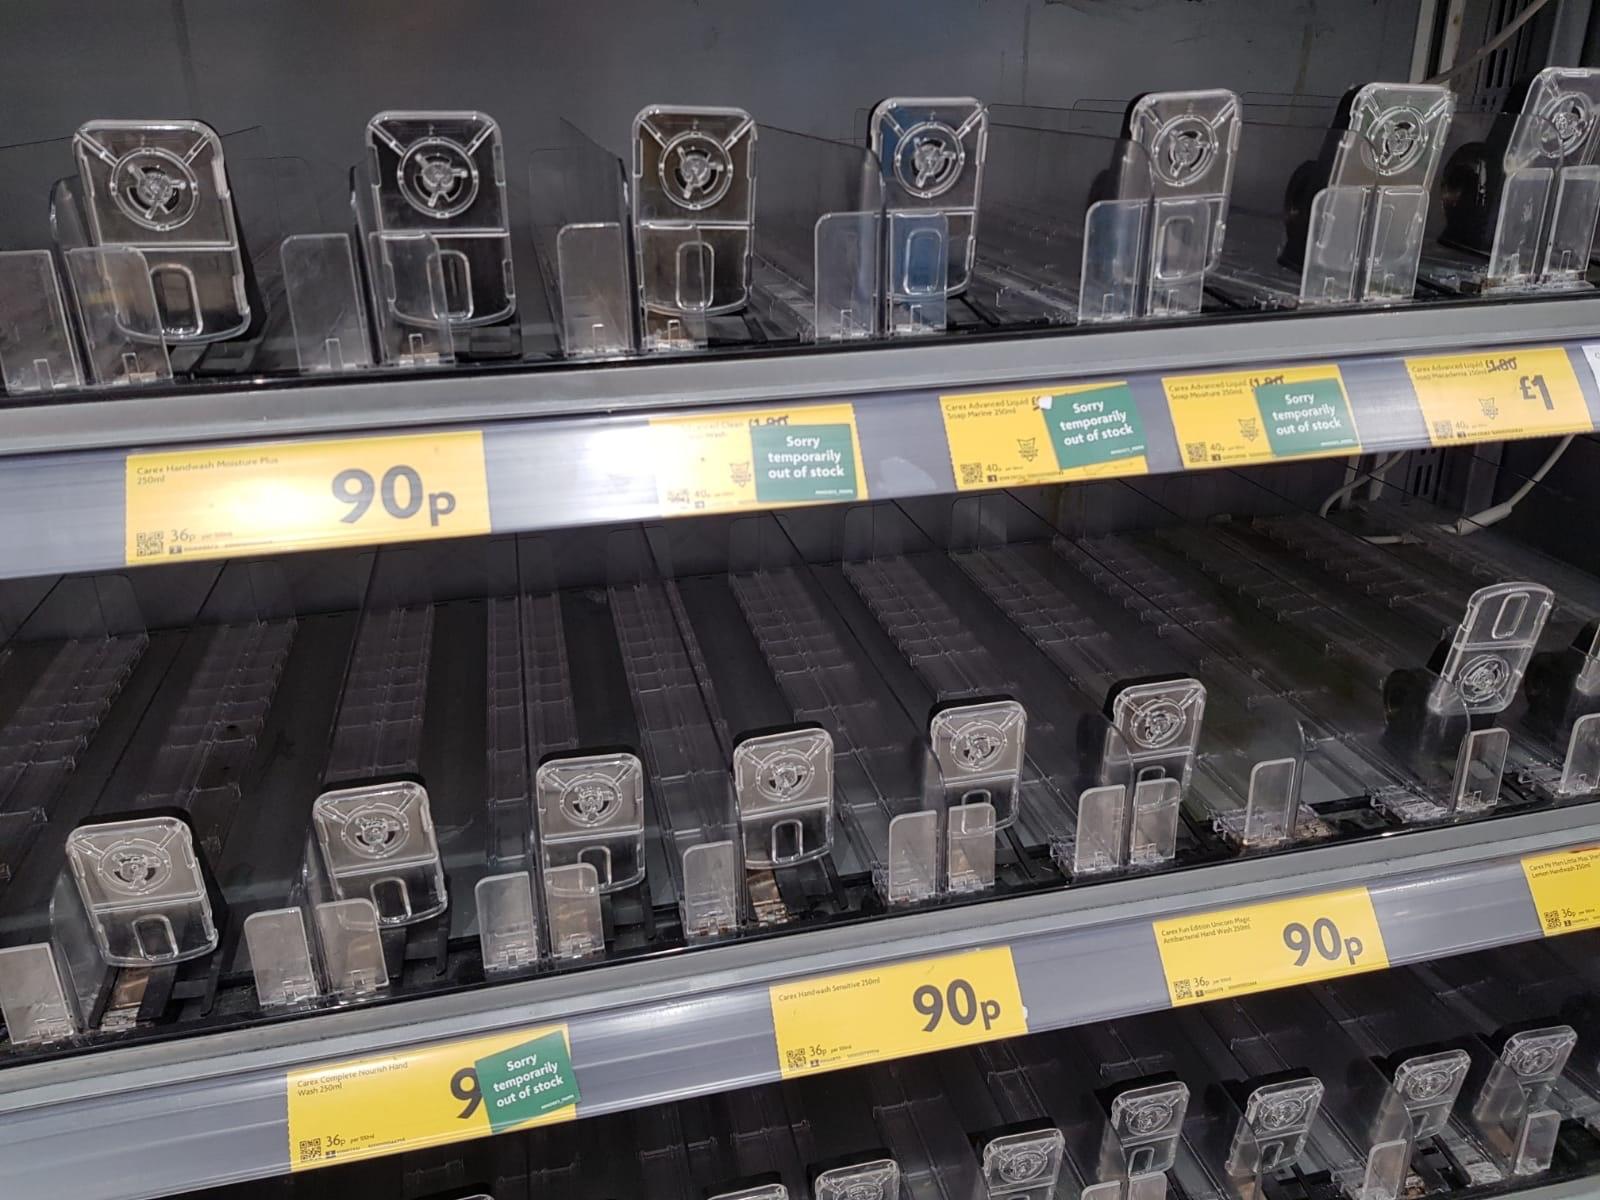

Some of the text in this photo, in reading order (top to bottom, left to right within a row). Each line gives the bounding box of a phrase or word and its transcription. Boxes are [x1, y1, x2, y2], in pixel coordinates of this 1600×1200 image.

[1285, 393, 1314, 405] Sorry
[1519, 374, 1555, 411] £1
[969, 400, 1004, 409] Advanced
[1073, 401, 1103, 413] Sorry
[1272, 403, 1335, 421] temporarily
[1060, 410, 1126, 431] temporarily
[1276, 416, 1341, 435] out of stock
[786, 435, 820, 449] Sorry
[1064, 423, 1133, 445] out of stock
[768, 449, 841, 466] temporarily
[137, 466, 163, 475] Carex
[166, 462, 214, 472] Handwash
[217, 459, 258, 468] Moisture
[768, 464, 845, 479] out of stock
[137, 475, 165, 485] 250ml
[332, 465, 456, 526] 90p
[170, 528, 196, 542] 36p
[1161, 929, 1178, 937] Carex
[1190, 922, 1210, 931] Edition
[1211, 919, 1234, 928] Unicorn
[1234, 916, 1251, 924] Magic
[1163, 933, 1199, 944] Antibacterial
[1200, 930, 1216, 938] Hand
[1217, 926, 1232, 935] Wash
[1283, 917, 1363, 967] 90p
[778, 976, 880, 1001] Carex Handwash Sensitive 250ml
[913, 979, 1001, 1032] 90p
[809, 1044, 827, 1056] 36p
[507, 1054, 537, 1071] Sorry
[297, 1061, 409, 1087] Carex Complete Nourish Hand
[493, 1061, 558, 1092] temporarily
[298, 1082, 343, 1096] Wash 250ml
[497, 1074, 564, 1107] out of stock
[326, 1134, 346, 1147] 36p
